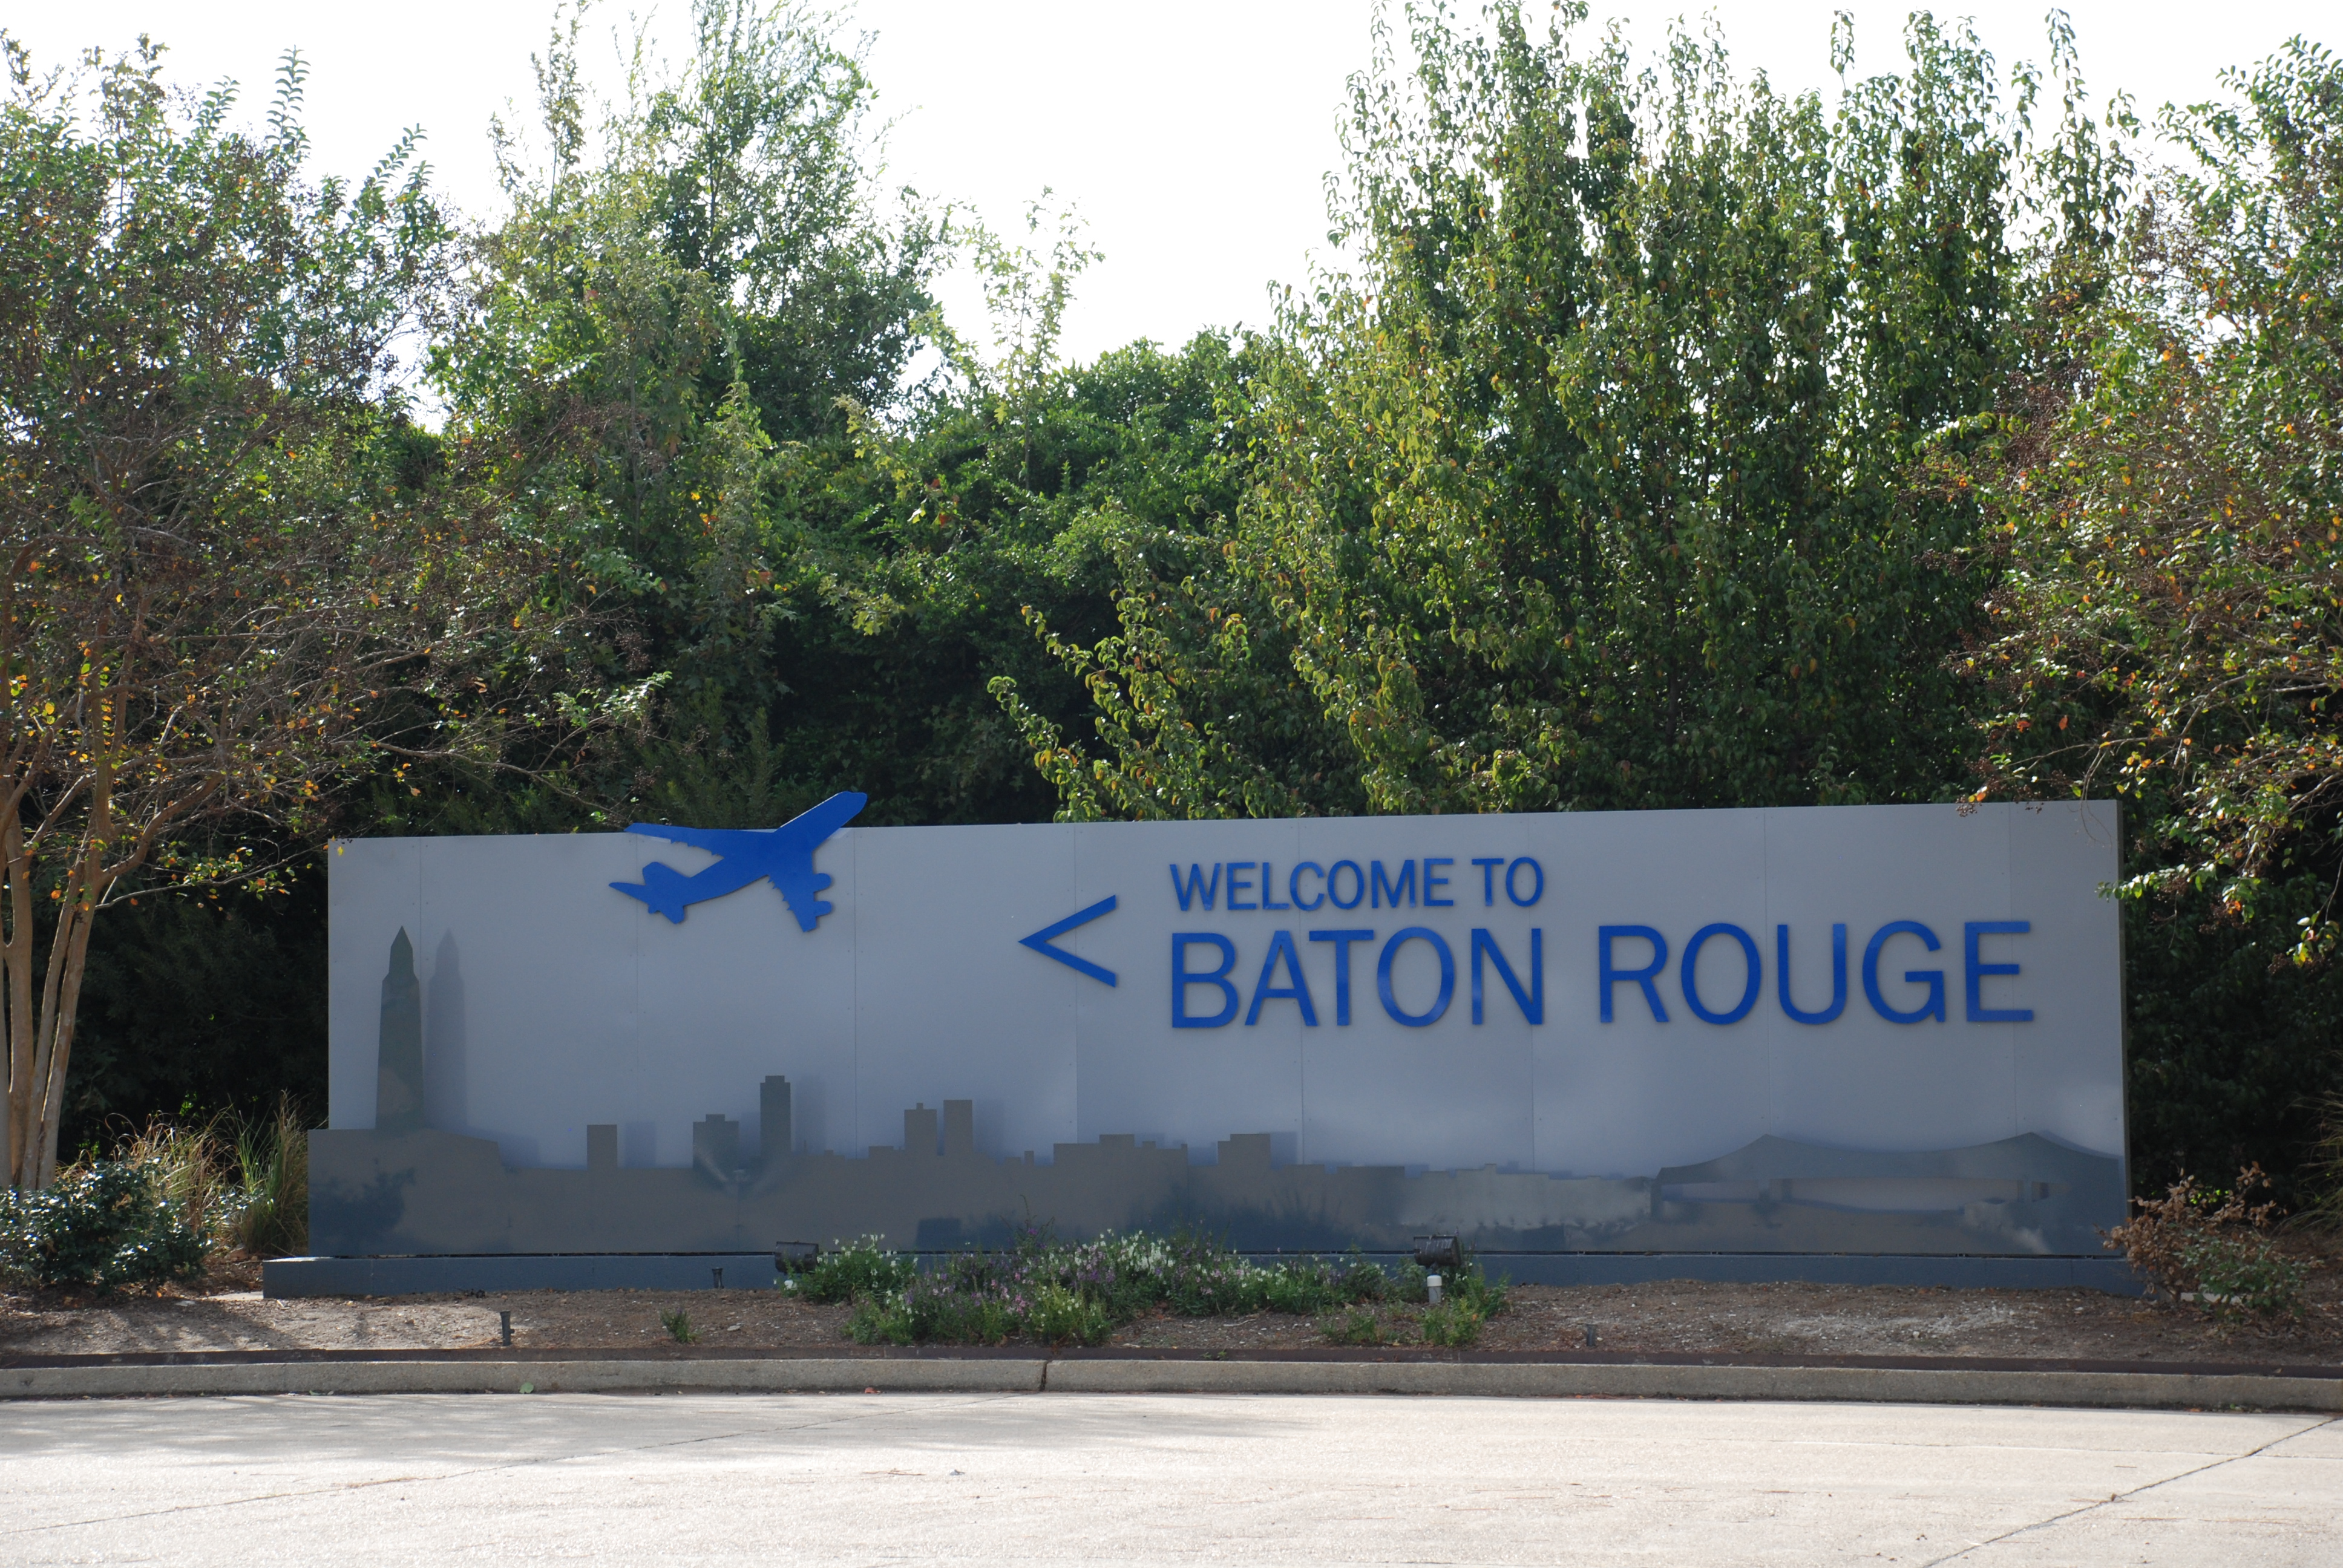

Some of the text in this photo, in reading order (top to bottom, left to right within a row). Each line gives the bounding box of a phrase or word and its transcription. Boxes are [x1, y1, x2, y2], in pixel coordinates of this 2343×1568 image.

[1169, 856, 1545, 912] WELCOME TO
[1171, 921, 2034, 1029] BATON ROUGE
